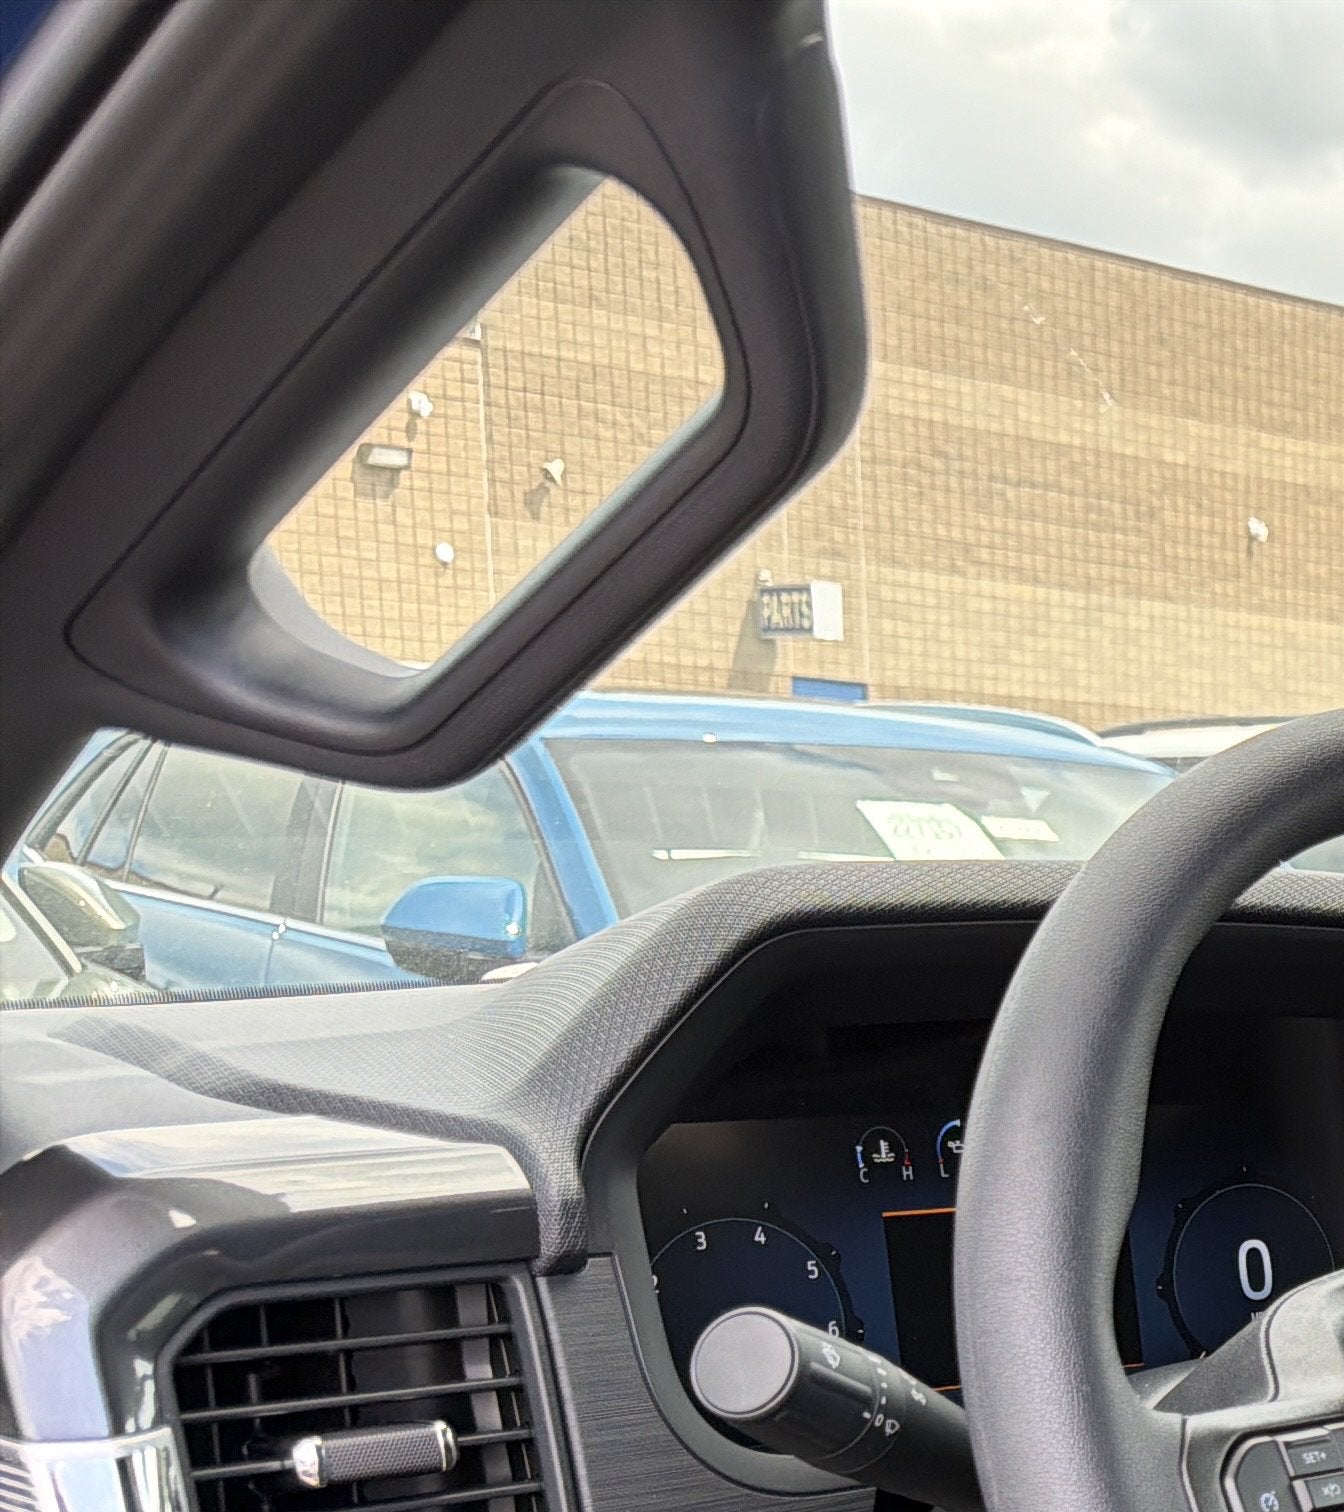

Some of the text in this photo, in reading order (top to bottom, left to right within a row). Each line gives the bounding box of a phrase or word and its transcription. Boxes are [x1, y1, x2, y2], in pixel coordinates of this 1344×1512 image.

[762, 591, 811, 630] PARTS
[860, 1169, 870, 1184] C
[902, 1166, 914, 1181] H
[939, 1164, 950, 1179] L
[695, 1231, 708, 1251] 3
[754, 1226, 766, 1245] 4
[807, 1260, 819, 1280] 5
[1238, 1239, 1273, 1300] 0
[828, 1320, 840, 1338] 6
